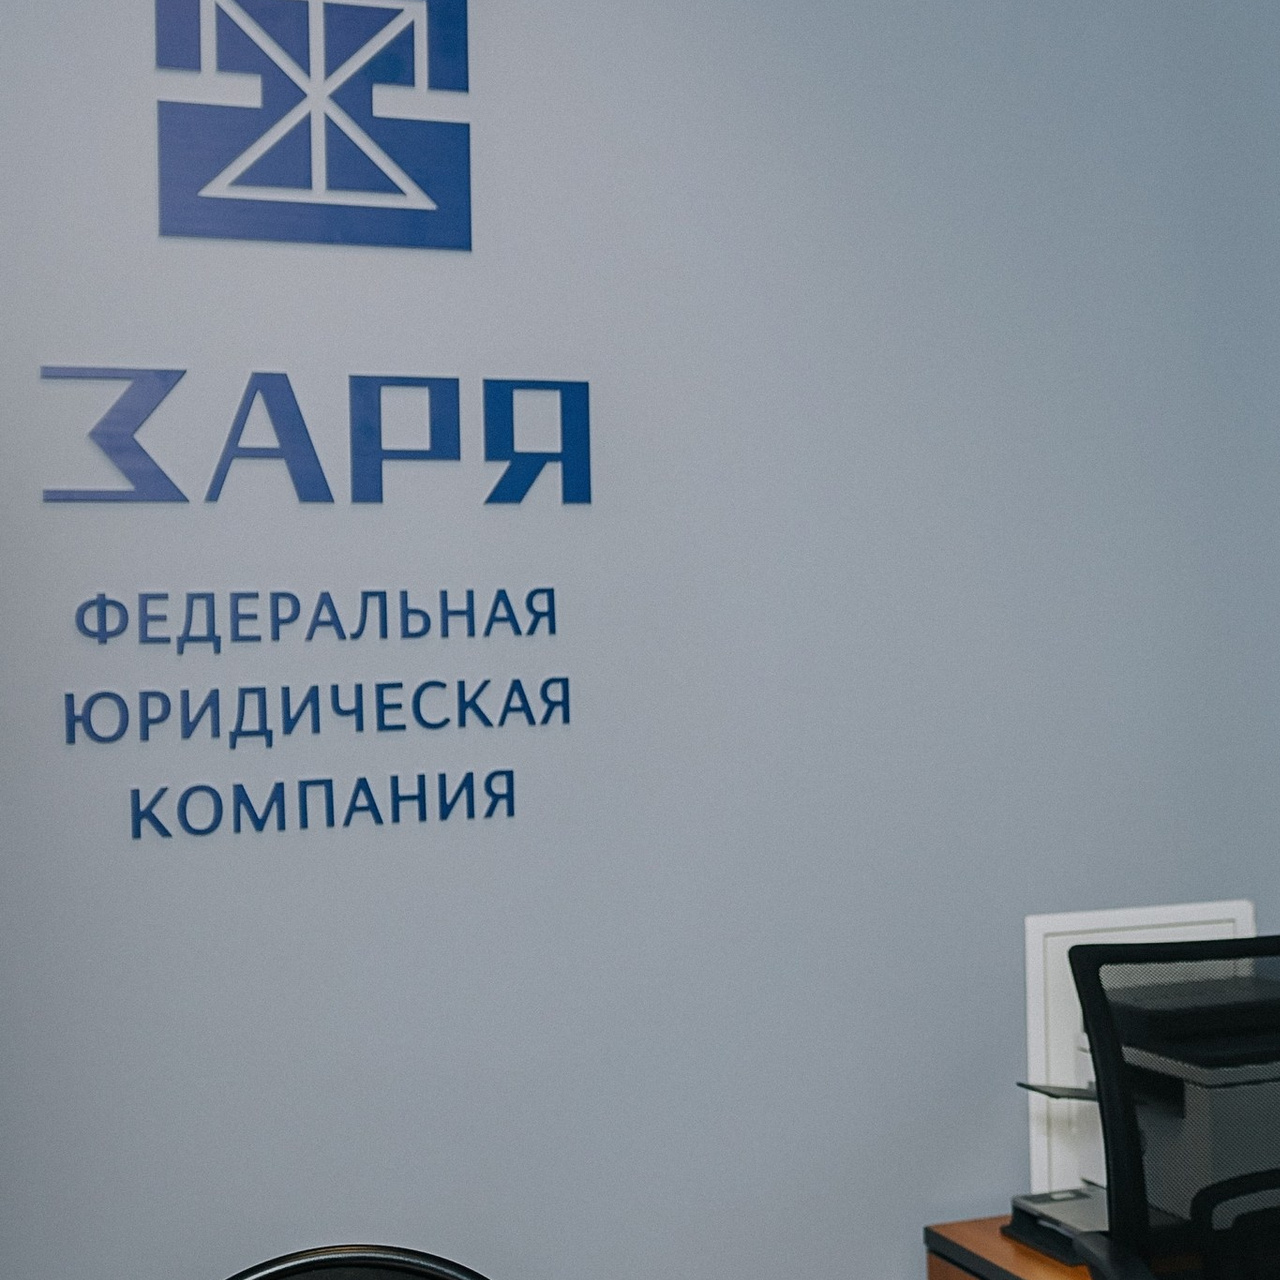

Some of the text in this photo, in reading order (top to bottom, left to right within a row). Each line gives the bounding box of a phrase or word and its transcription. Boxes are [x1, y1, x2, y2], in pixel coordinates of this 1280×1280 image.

[39, 364, 592, 505] ЗАРЯ
[74, 587, 558, 655] ФЕДЕРАЛЬНАЯ
[63, 676, 572, 750] ЮРИДИЧЕСКАЯ
[130, 769, 518, 841] КОМПАНИЯ
